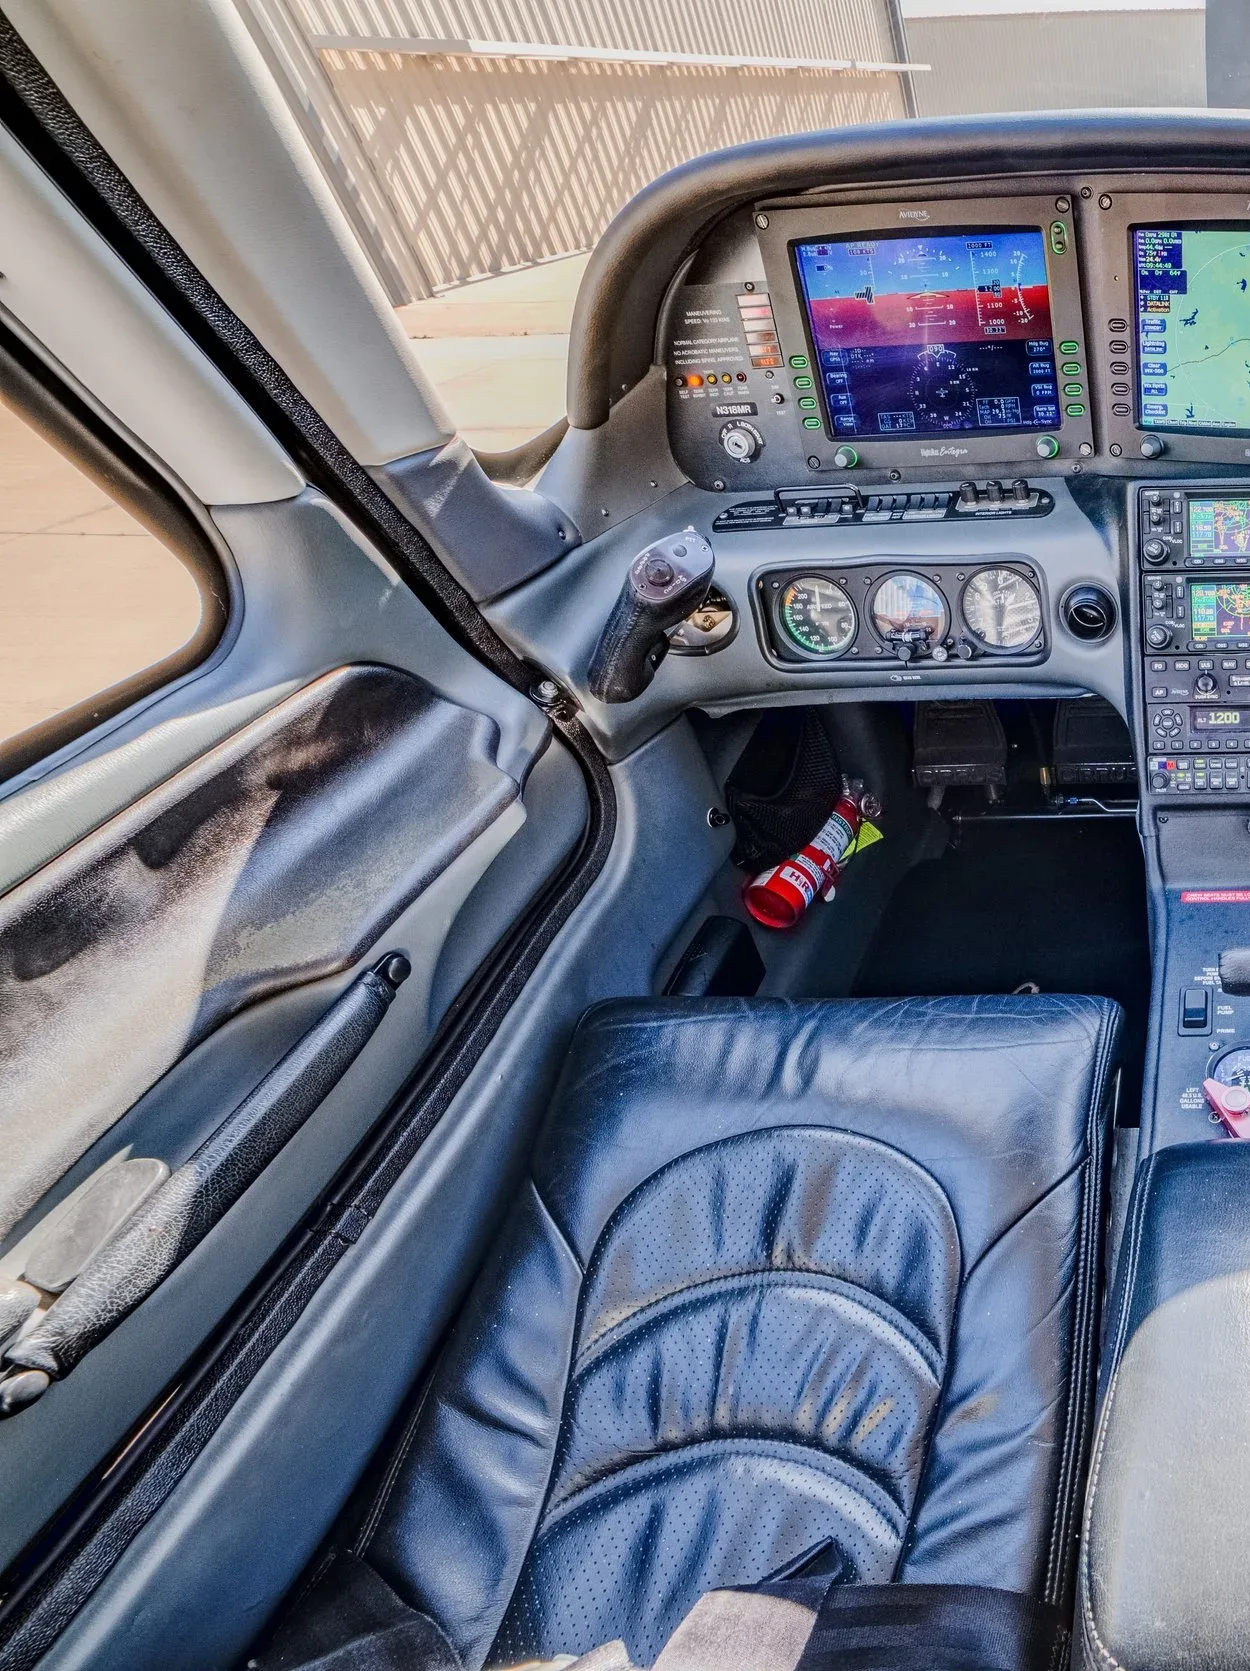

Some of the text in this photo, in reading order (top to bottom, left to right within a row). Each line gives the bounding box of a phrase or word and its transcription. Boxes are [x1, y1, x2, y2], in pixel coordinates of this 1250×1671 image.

[899, 210, 930, 219] AVIDYNE
[716, 405, 751, 415] N318MR
[940, 446, 968, 457] Entegra
[1209, 712, 1240, 724] 1200
